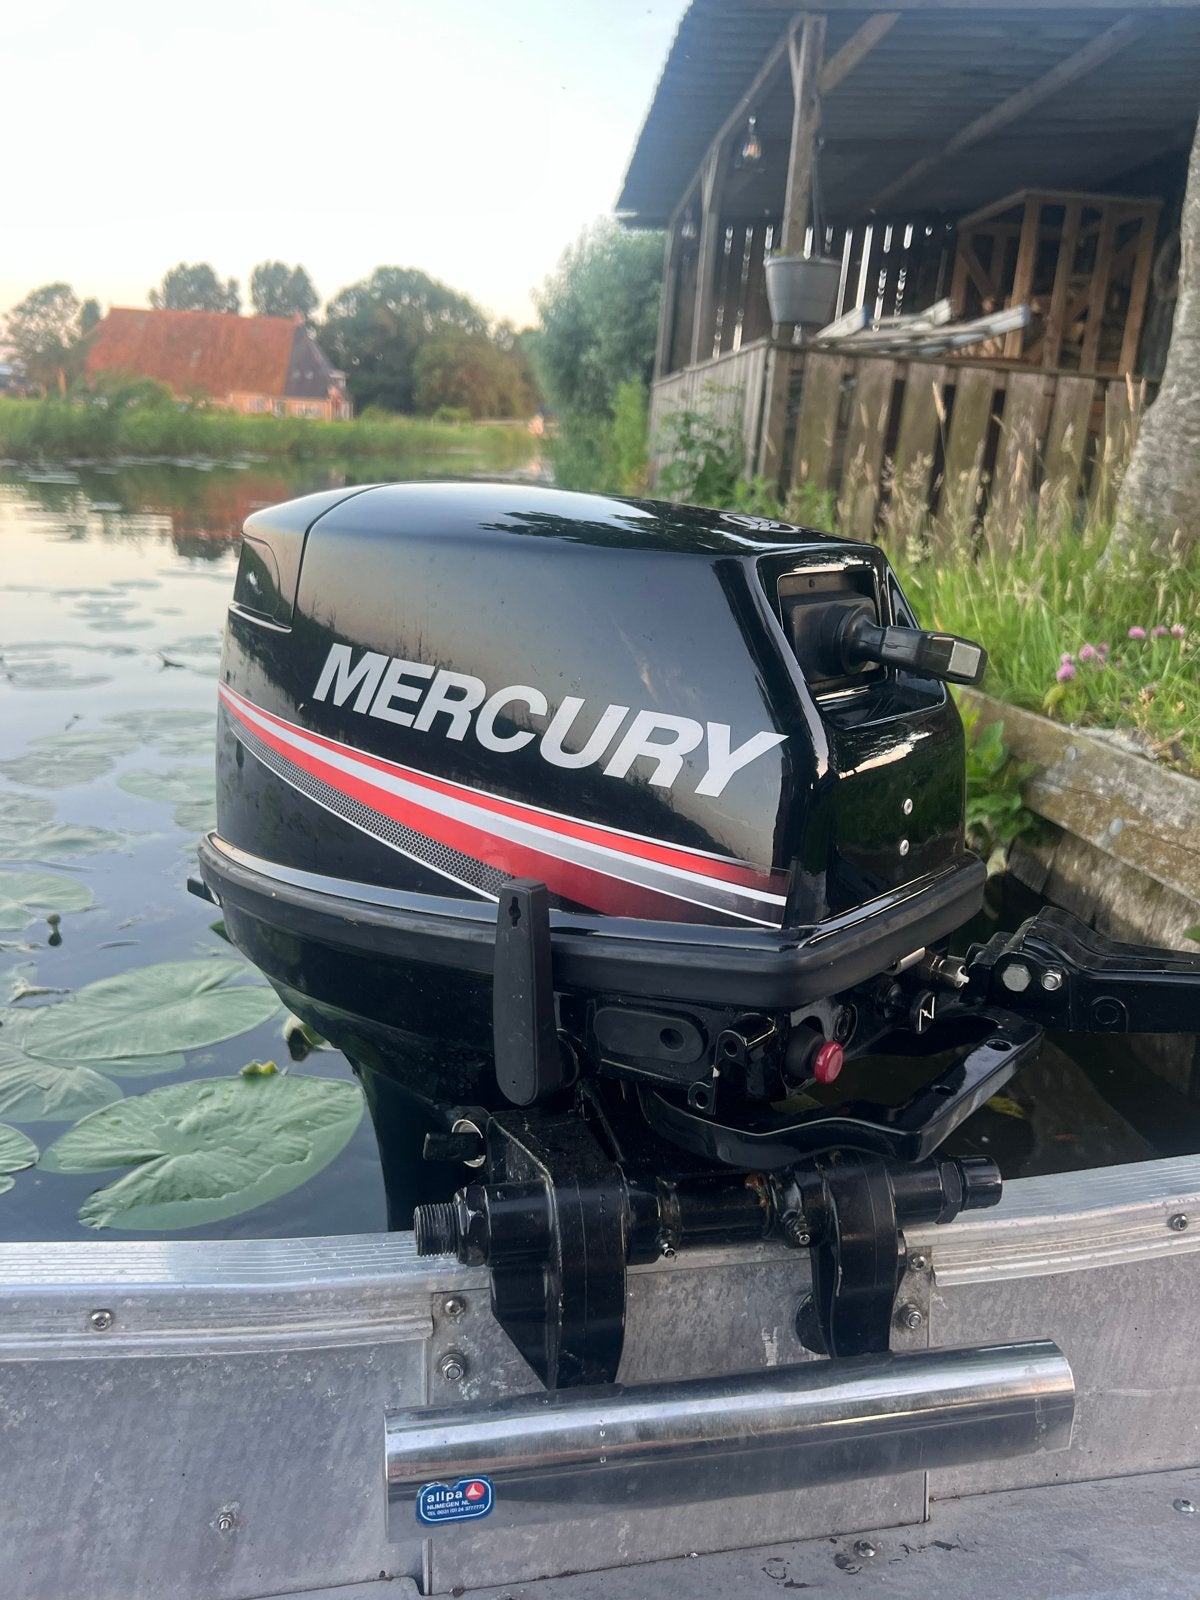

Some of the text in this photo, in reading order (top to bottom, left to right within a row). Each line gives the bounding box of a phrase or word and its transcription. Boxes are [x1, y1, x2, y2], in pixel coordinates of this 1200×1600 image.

[313, 643, 789, 797] MERCURY
[427, 1491, 463, 1502] allpa
[427, 1501, 460, 1510] NIJMEGEN
